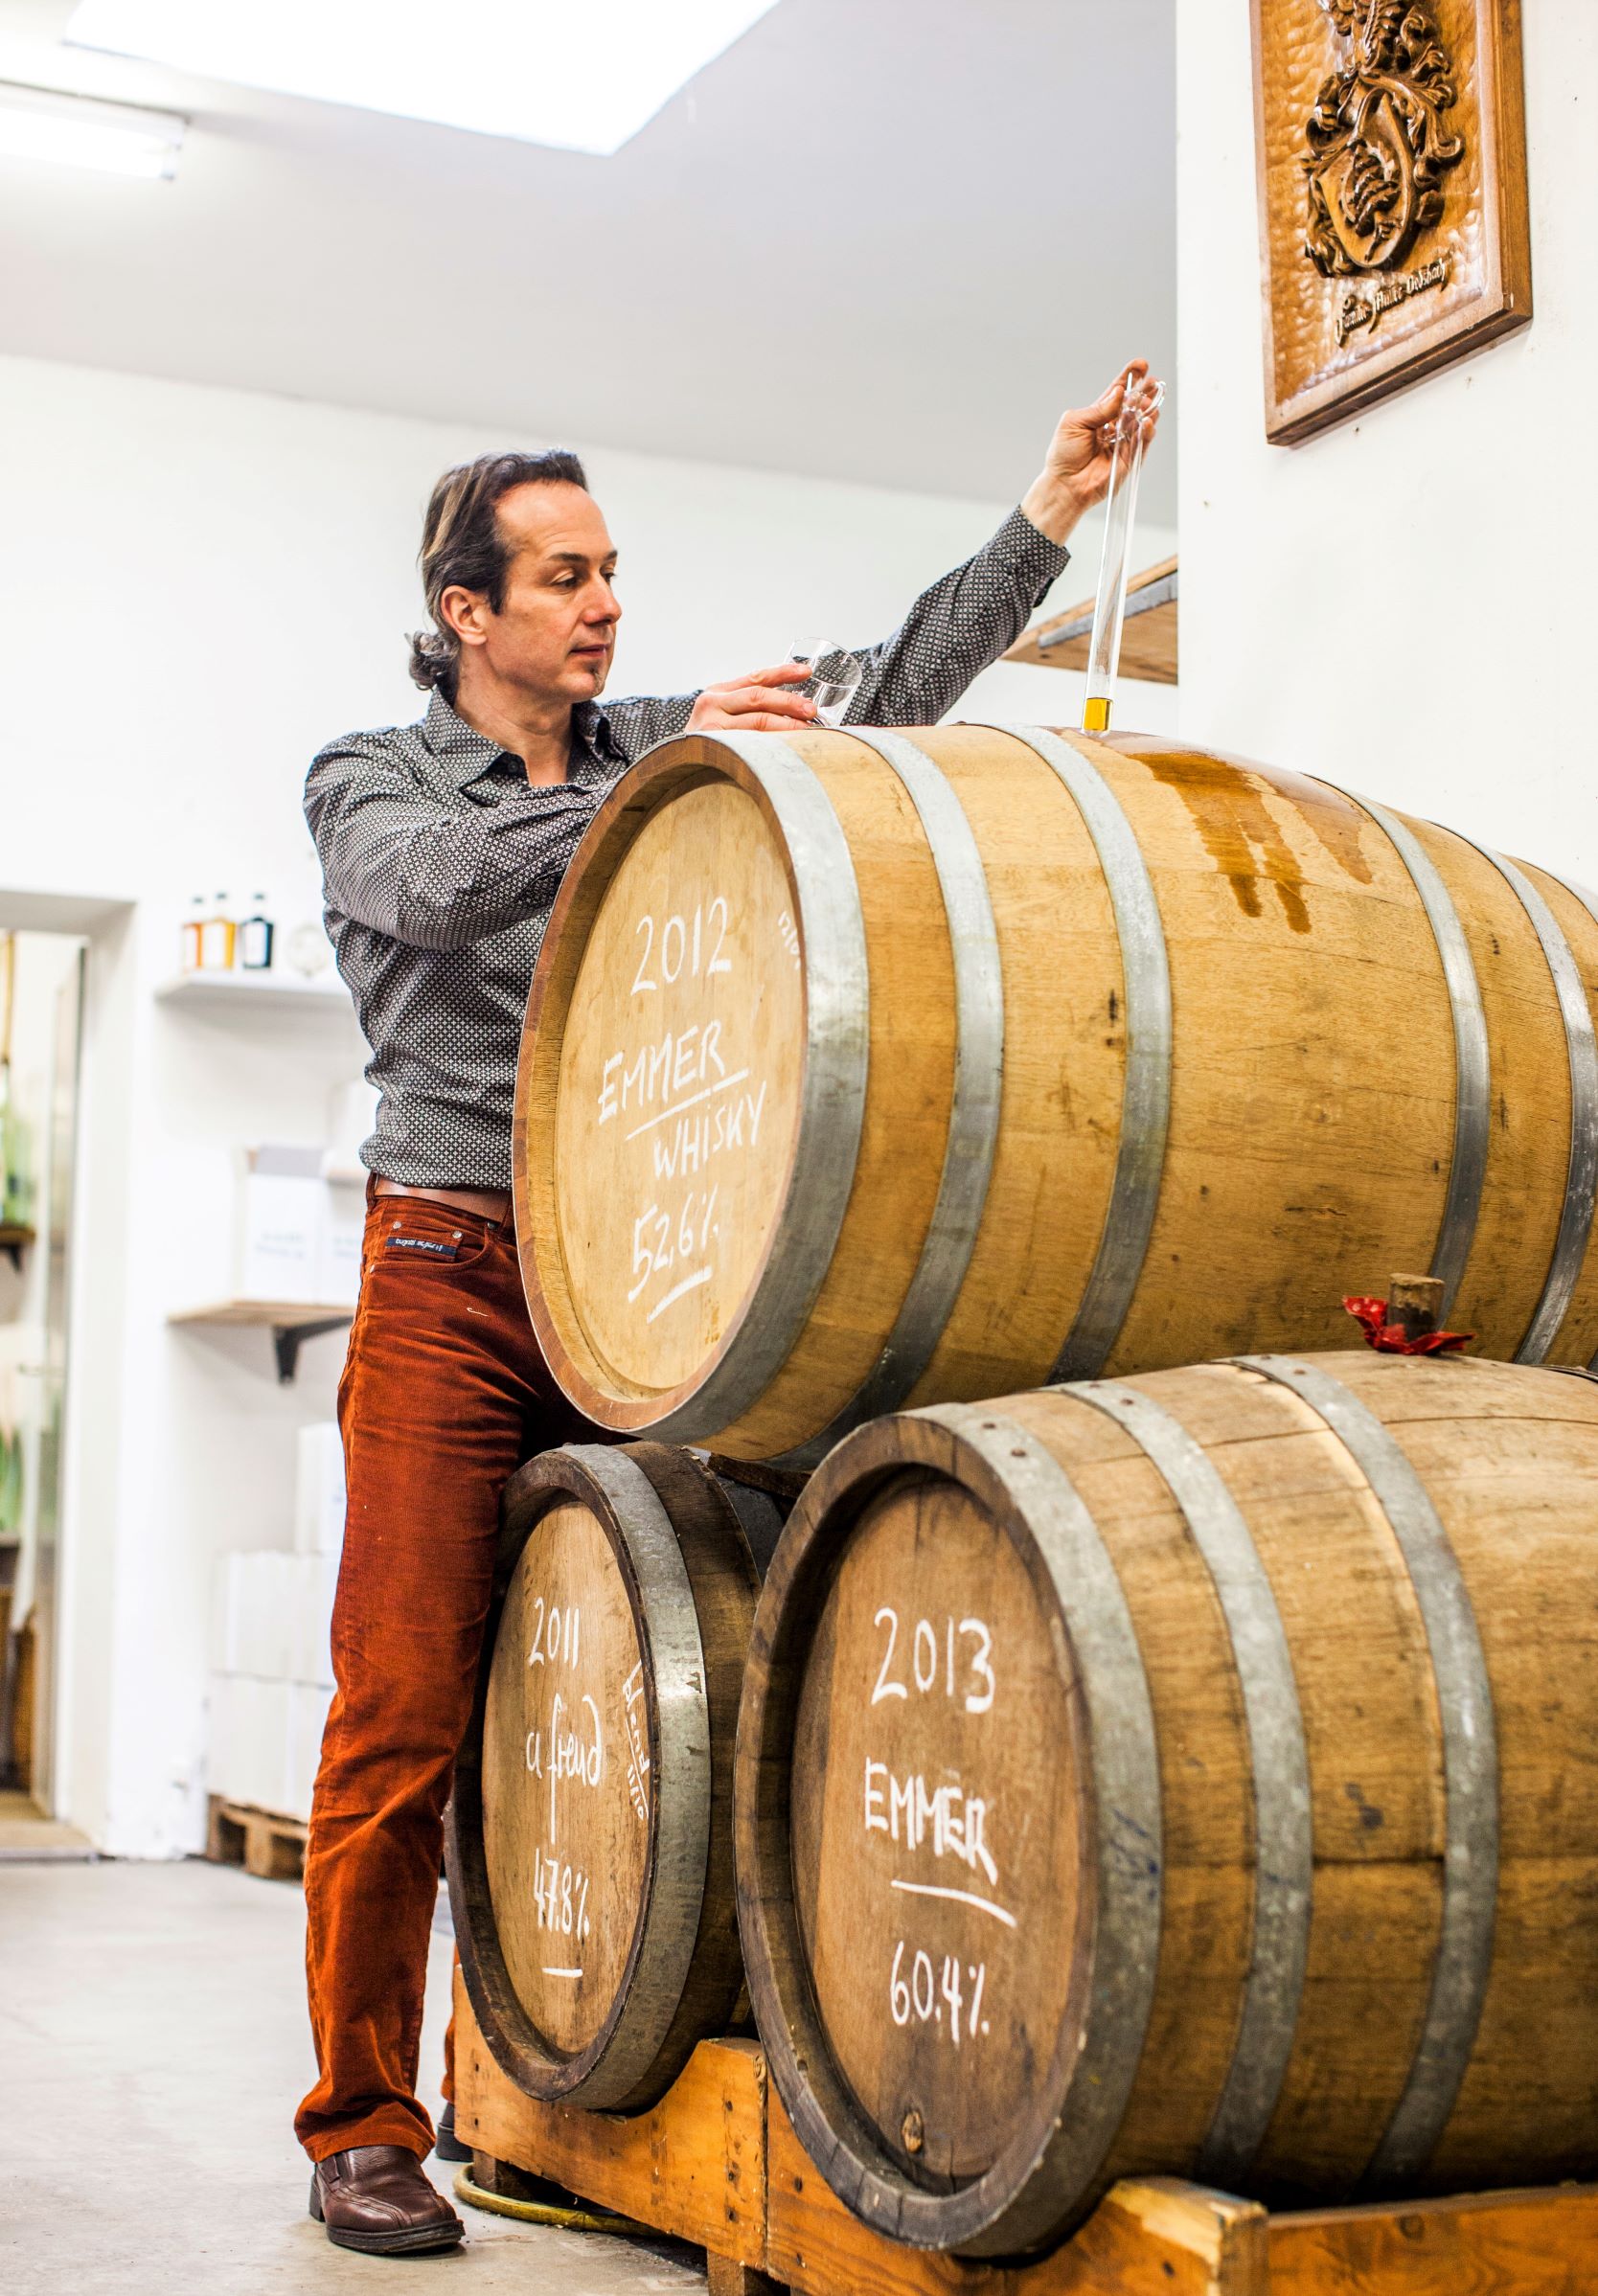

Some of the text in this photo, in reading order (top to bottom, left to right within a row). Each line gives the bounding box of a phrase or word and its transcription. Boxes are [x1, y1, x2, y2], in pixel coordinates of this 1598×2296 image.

[630, 896, 731, 995] 2012
[599, 1018, 726, 1125] EMMER
[529, 1597, 581, 1670] 2011
[871, 1606, 995, 1714] 2013
[526, 1732, 543, 1780] a
[865, 1756, 998, 1885] EMMER
